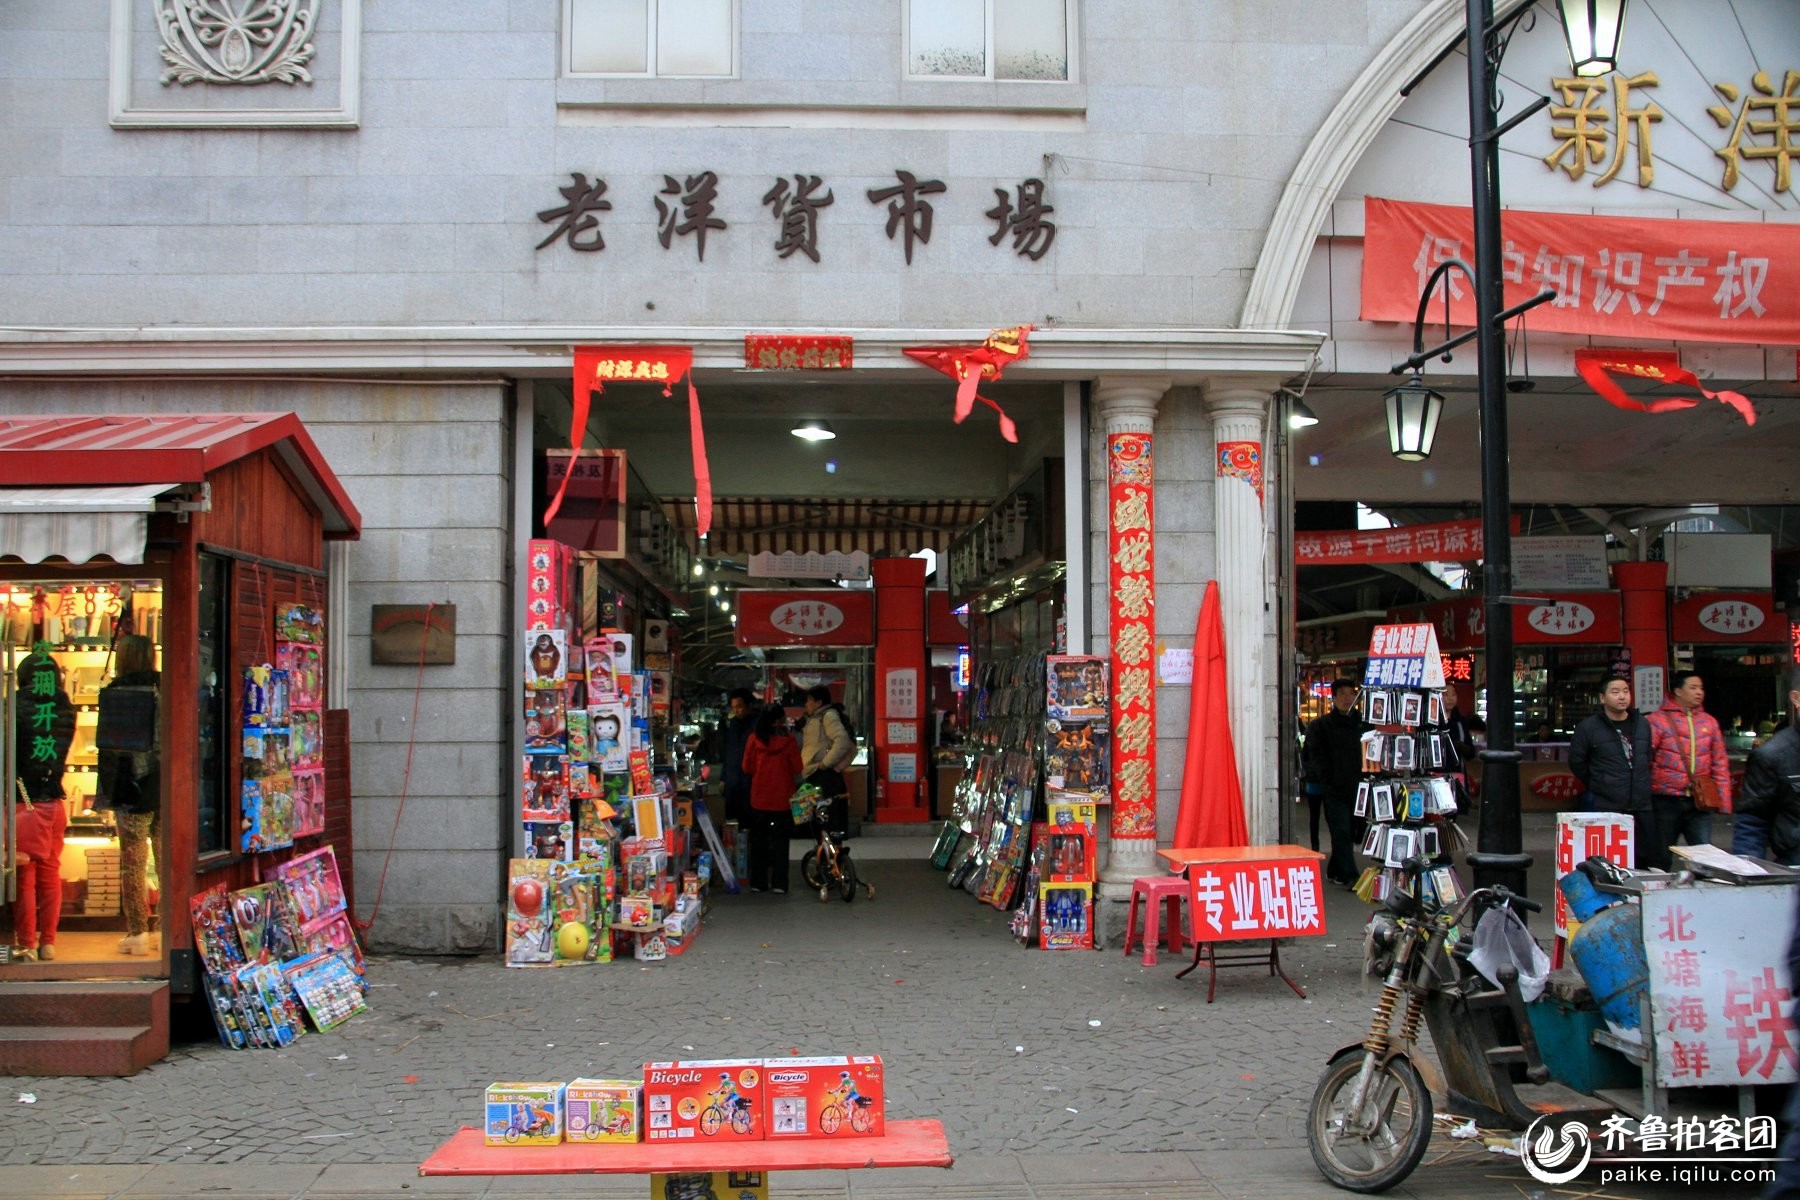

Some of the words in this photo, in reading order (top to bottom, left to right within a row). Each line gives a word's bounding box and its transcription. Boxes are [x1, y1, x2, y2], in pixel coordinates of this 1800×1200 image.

[1543, 70, 1800, 193] 新洋
[535, 169, 1056, 266] 老洋貨市場
[1372, 625, 1429, 655] 专业贴膜
[1367, 658, 1423, 685] 手机配件
[1197, 866, 1320, 935] 专业贴膜
[1658, 904, 1711, 1079] 北塘海鲜
[650, 1069, 703, 1086] Bicycle
[773, 1074, 805, 1082] Bicycle
